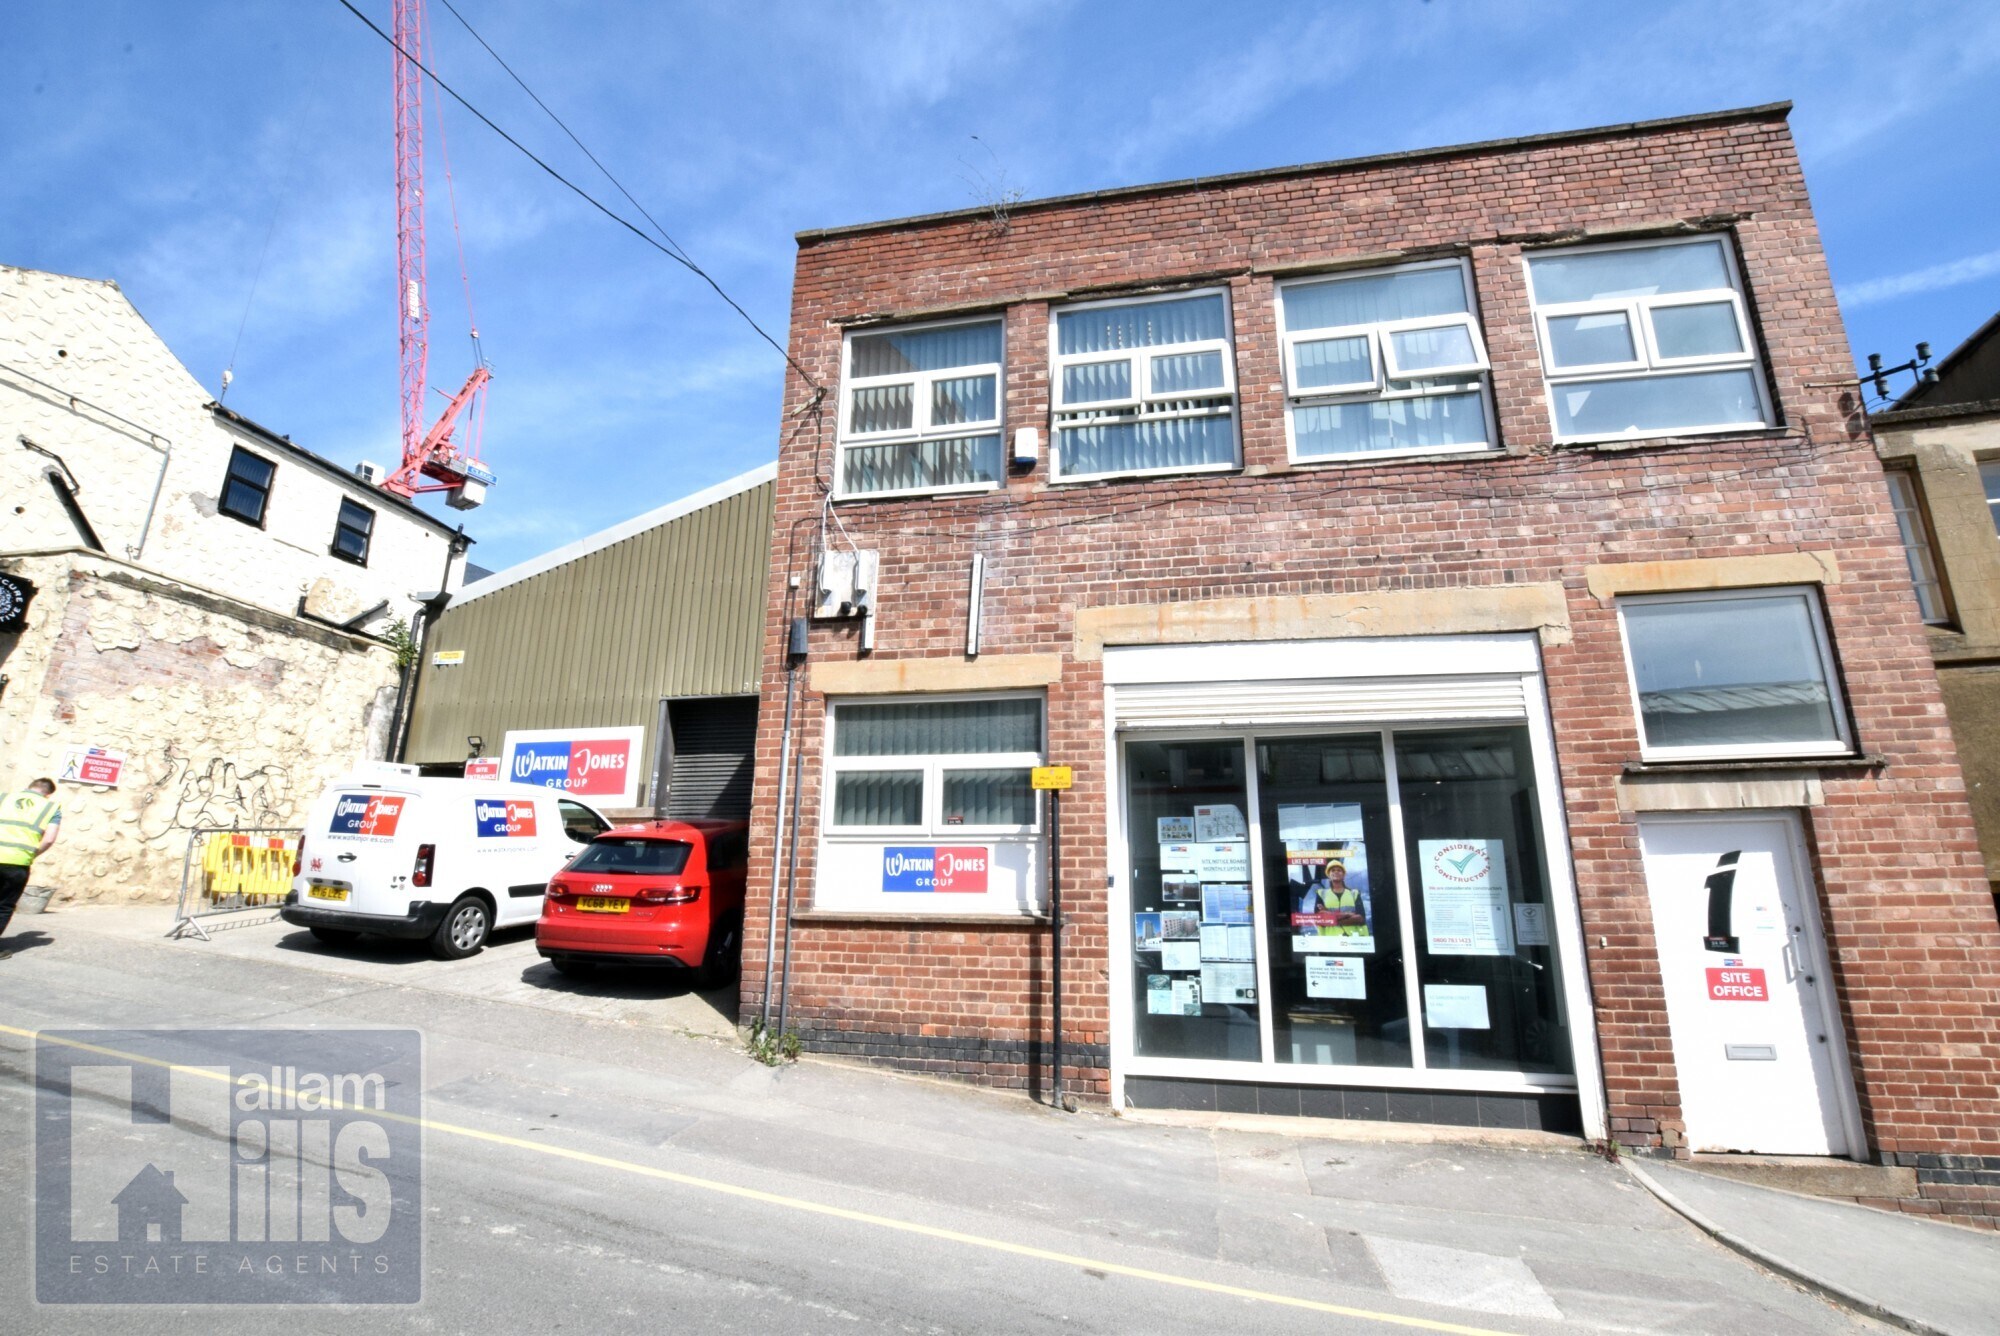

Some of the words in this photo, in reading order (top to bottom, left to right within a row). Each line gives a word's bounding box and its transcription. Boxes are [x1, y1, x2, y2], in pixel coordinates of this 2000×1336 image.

[84, 758, 120, 768] PEDESTRIAN
[515, 750, 568, 777] WATKIN
[574, 749, 625, 776] JONES
[89, 766, 112, 774] ACCESS
[88, 772, 109, 780] ROUTE
[546, 778, 588, 788] GROUP
[337, 798, 368, 816] WATKIN
[369, 799, 399, 818] JONES
[477, 803, 506, 821] WATKIN
[508, 804, 534, 821] JONES
[347, 820, 378, 829] GROUP
[494, 824, 521, 832] GROUP
[1434, 844, 1490, 861] CONSIDERATE
[885, 853, 933, 876] WATKIN
[938, 853, 985, 876] JONES
[1434, 865, 1490, 882] CONSTRUCTORS
[915, 878, 953, 886] GROUP
[1721, 972, 1751, 983] SITE
[1713, 985, 1763, 997] OFFICE
